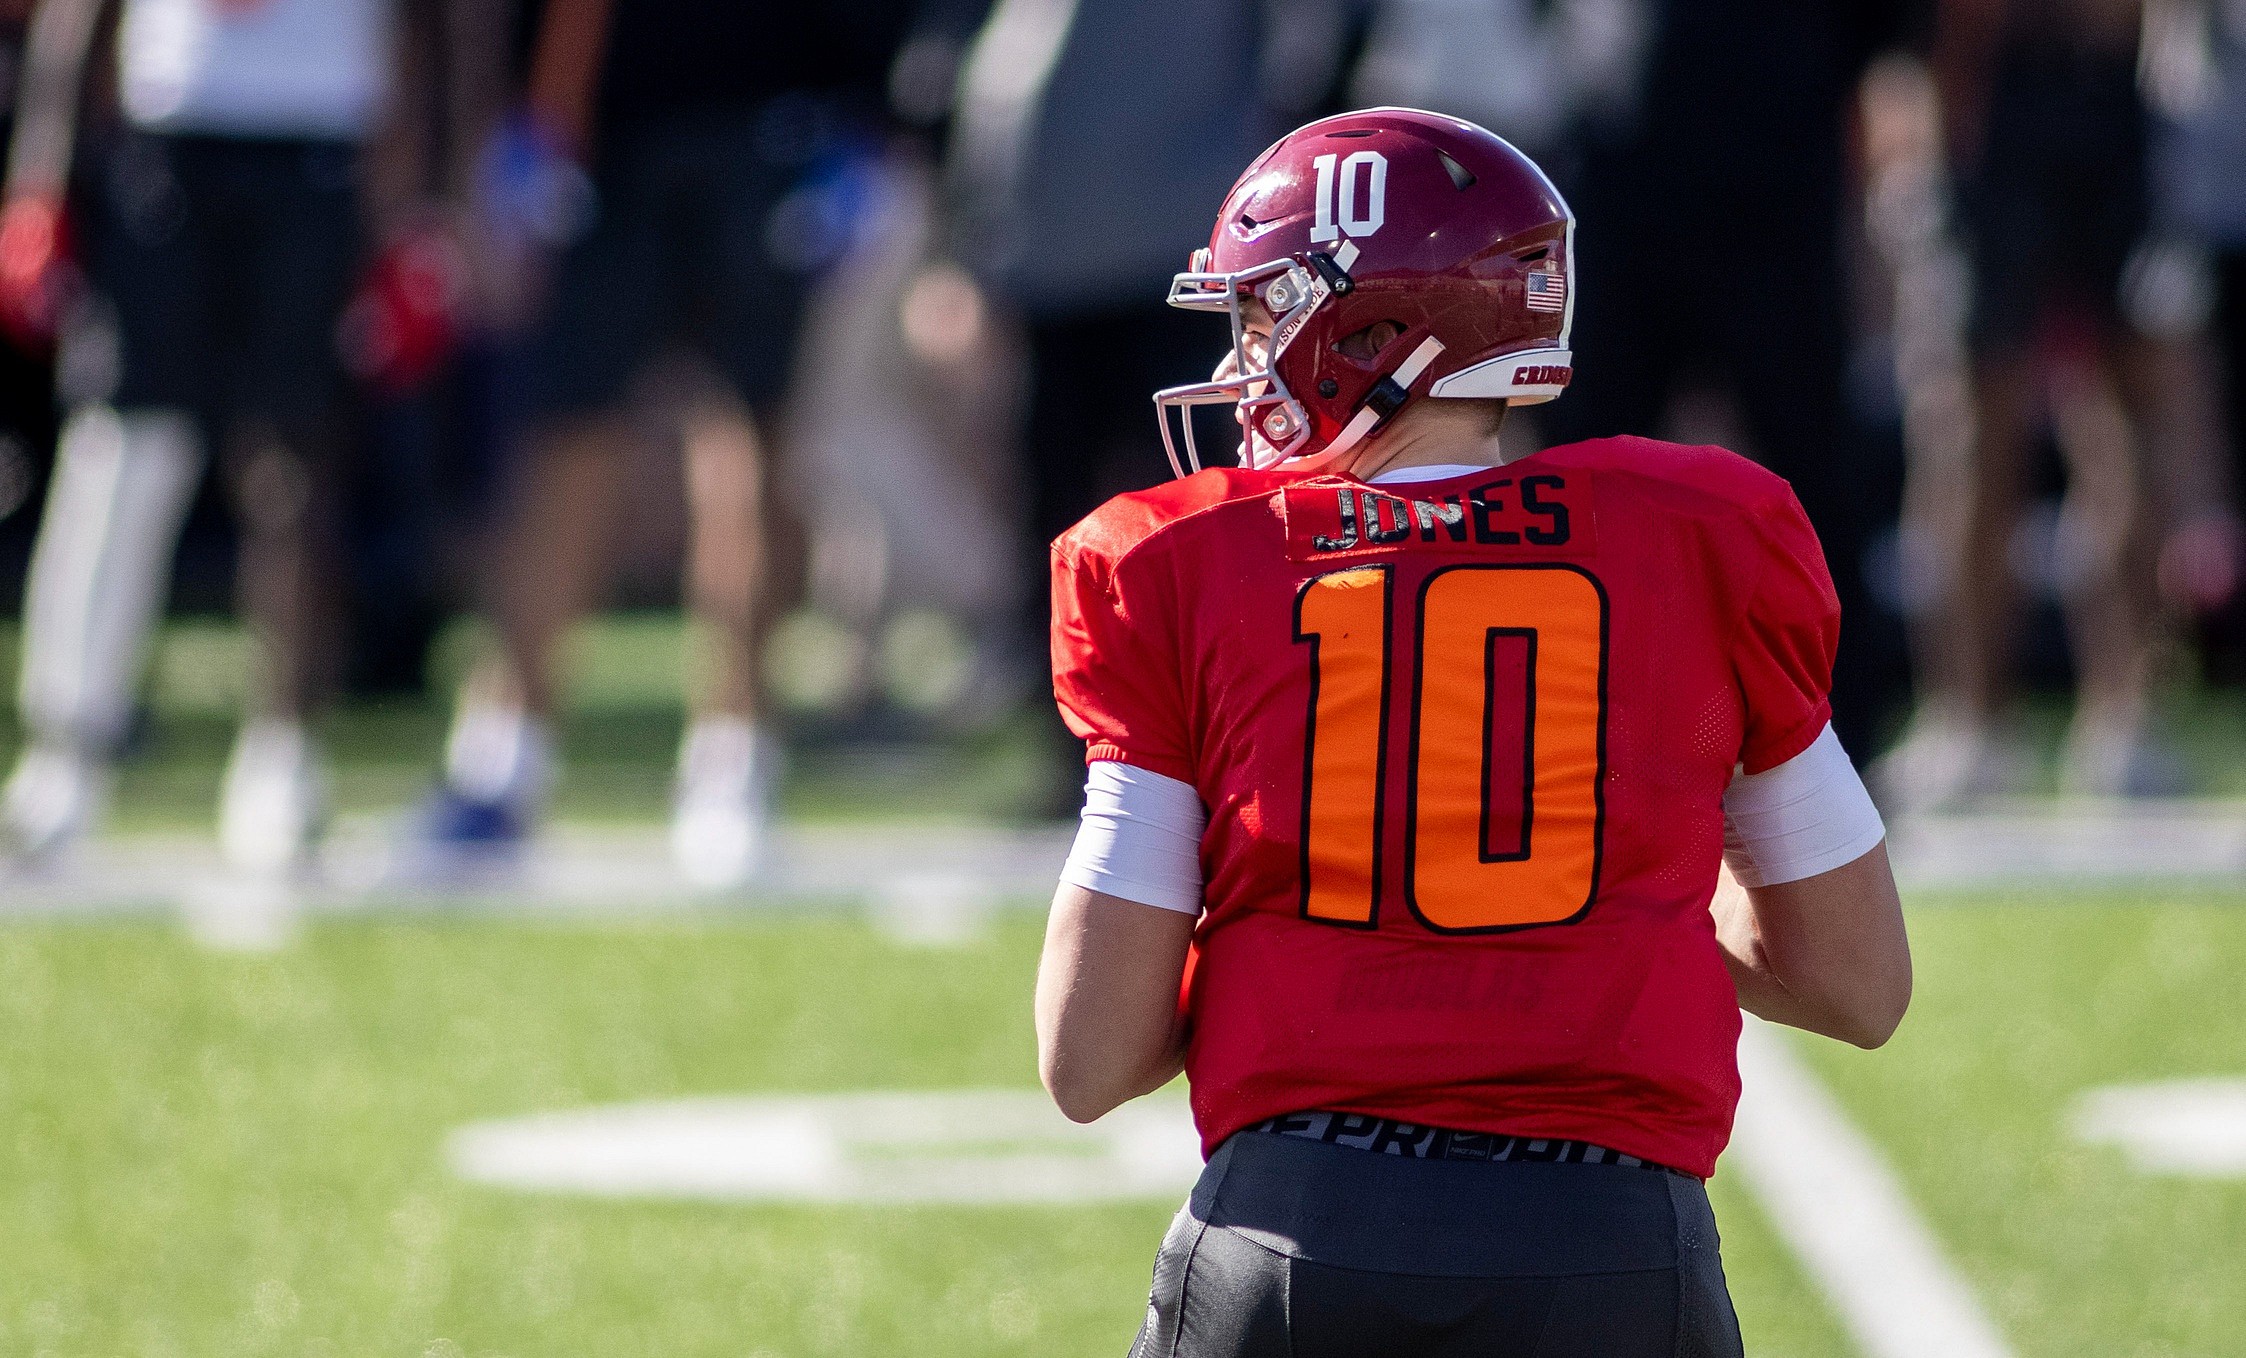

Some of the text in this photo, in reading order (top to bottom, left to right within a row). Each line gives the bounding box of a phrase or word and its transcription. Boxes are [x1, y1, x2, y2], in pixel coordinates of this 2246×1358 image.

[1310, 151, 1387, 243] 10
[1312, 475, 1571, 551] JONES
[1292, 562, 1610, 936] 10
